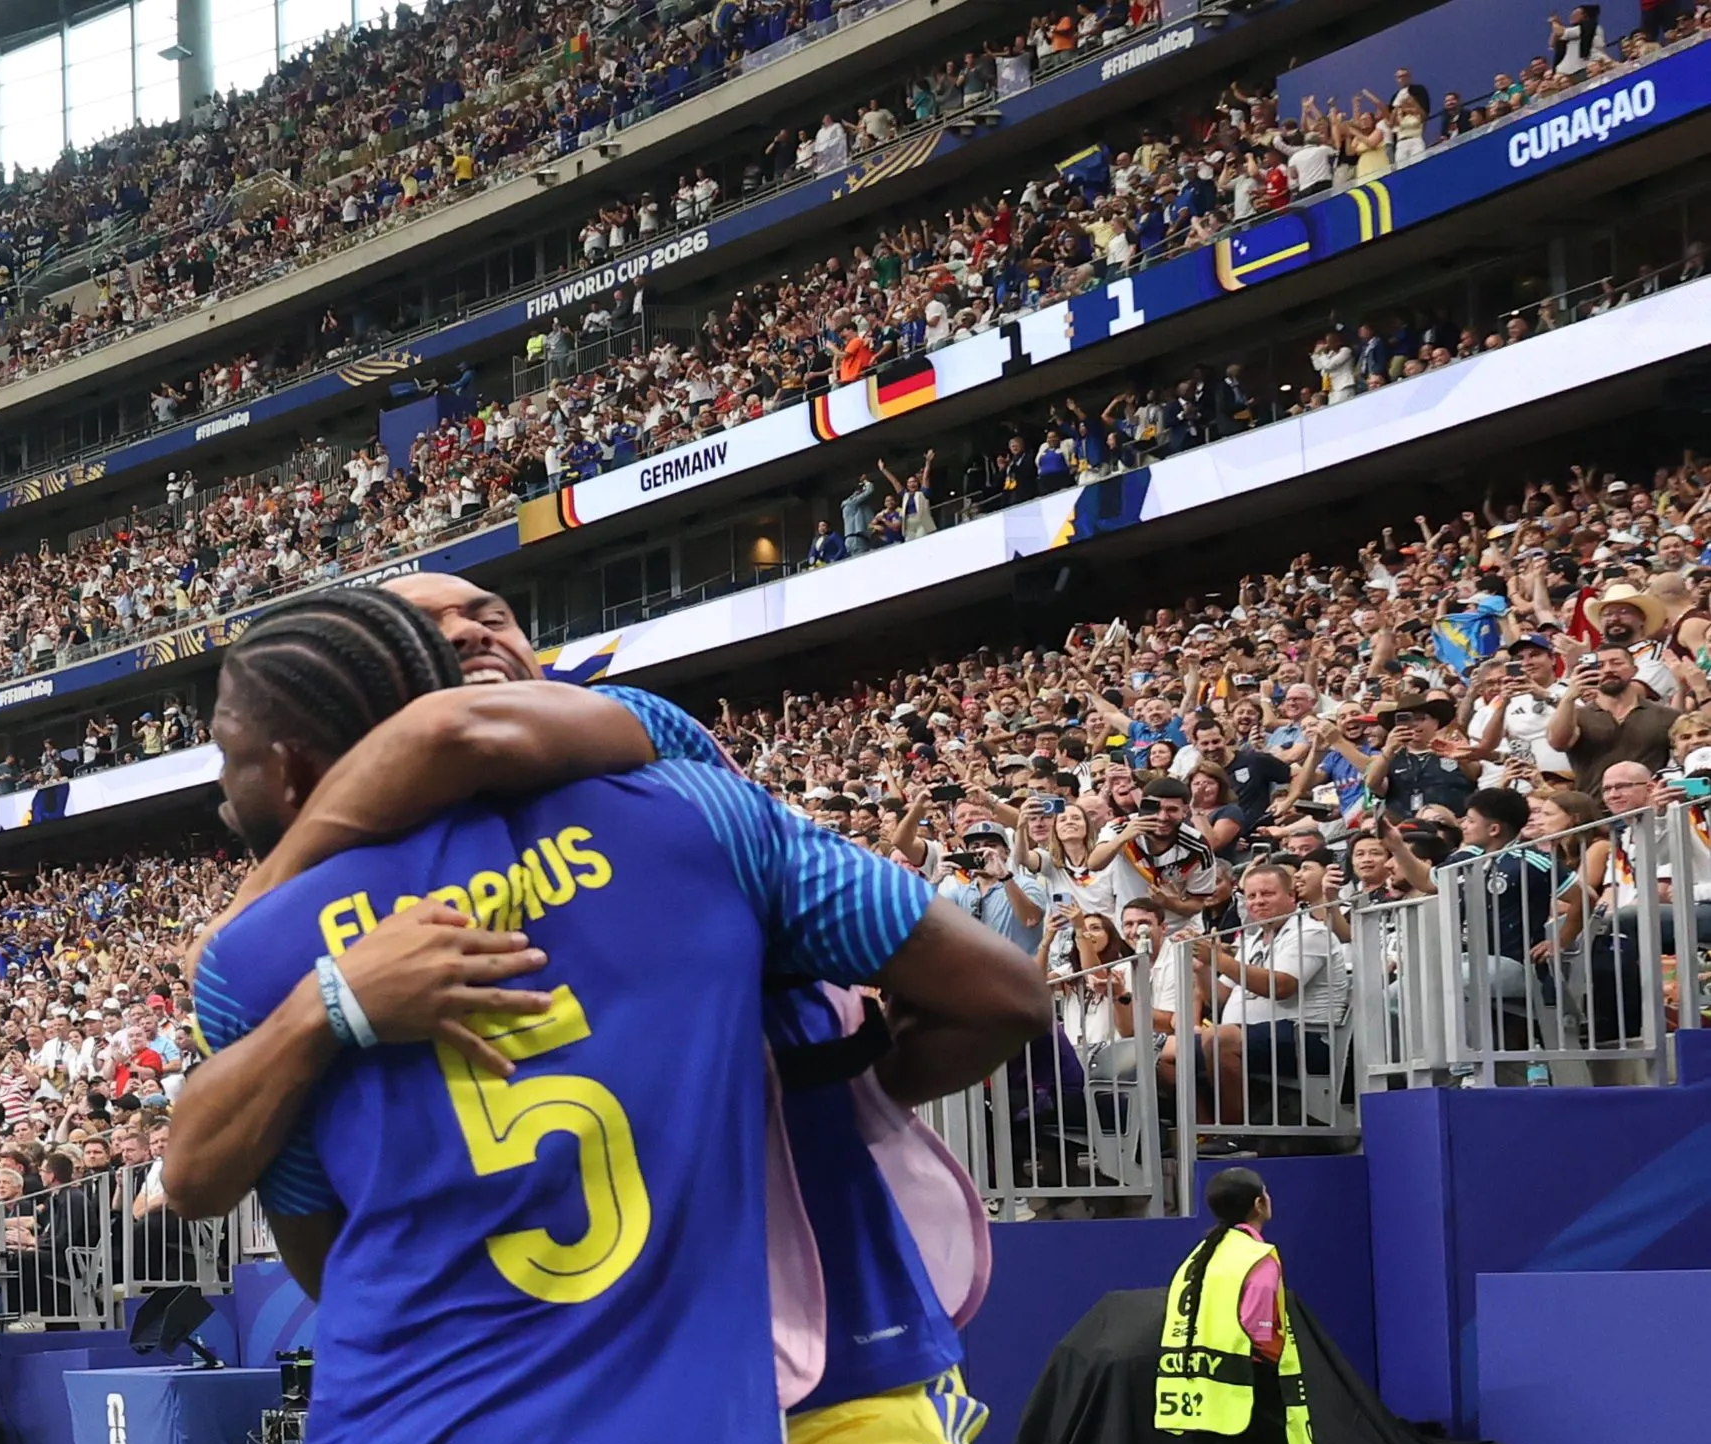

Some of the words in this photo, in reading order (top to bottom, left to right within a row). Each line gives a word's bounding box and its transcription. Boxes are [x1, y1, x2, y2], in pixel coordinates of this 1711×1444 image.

[1101, 27, 1195, 80] #FIFAWorldCup
[1508, 79, 1656, 168] CURAÇAO
[526, 290, 559, 320] FIFA
[559, 269, 616, 306] WORLD
[617, 255, 649, 283] CUP
[650, 231, 710, 270] 2026
[1107, 277, 1144, 337] 1
[640, 441, 728, 492] GERMANY
[434, 984, 652, 1304] 5
